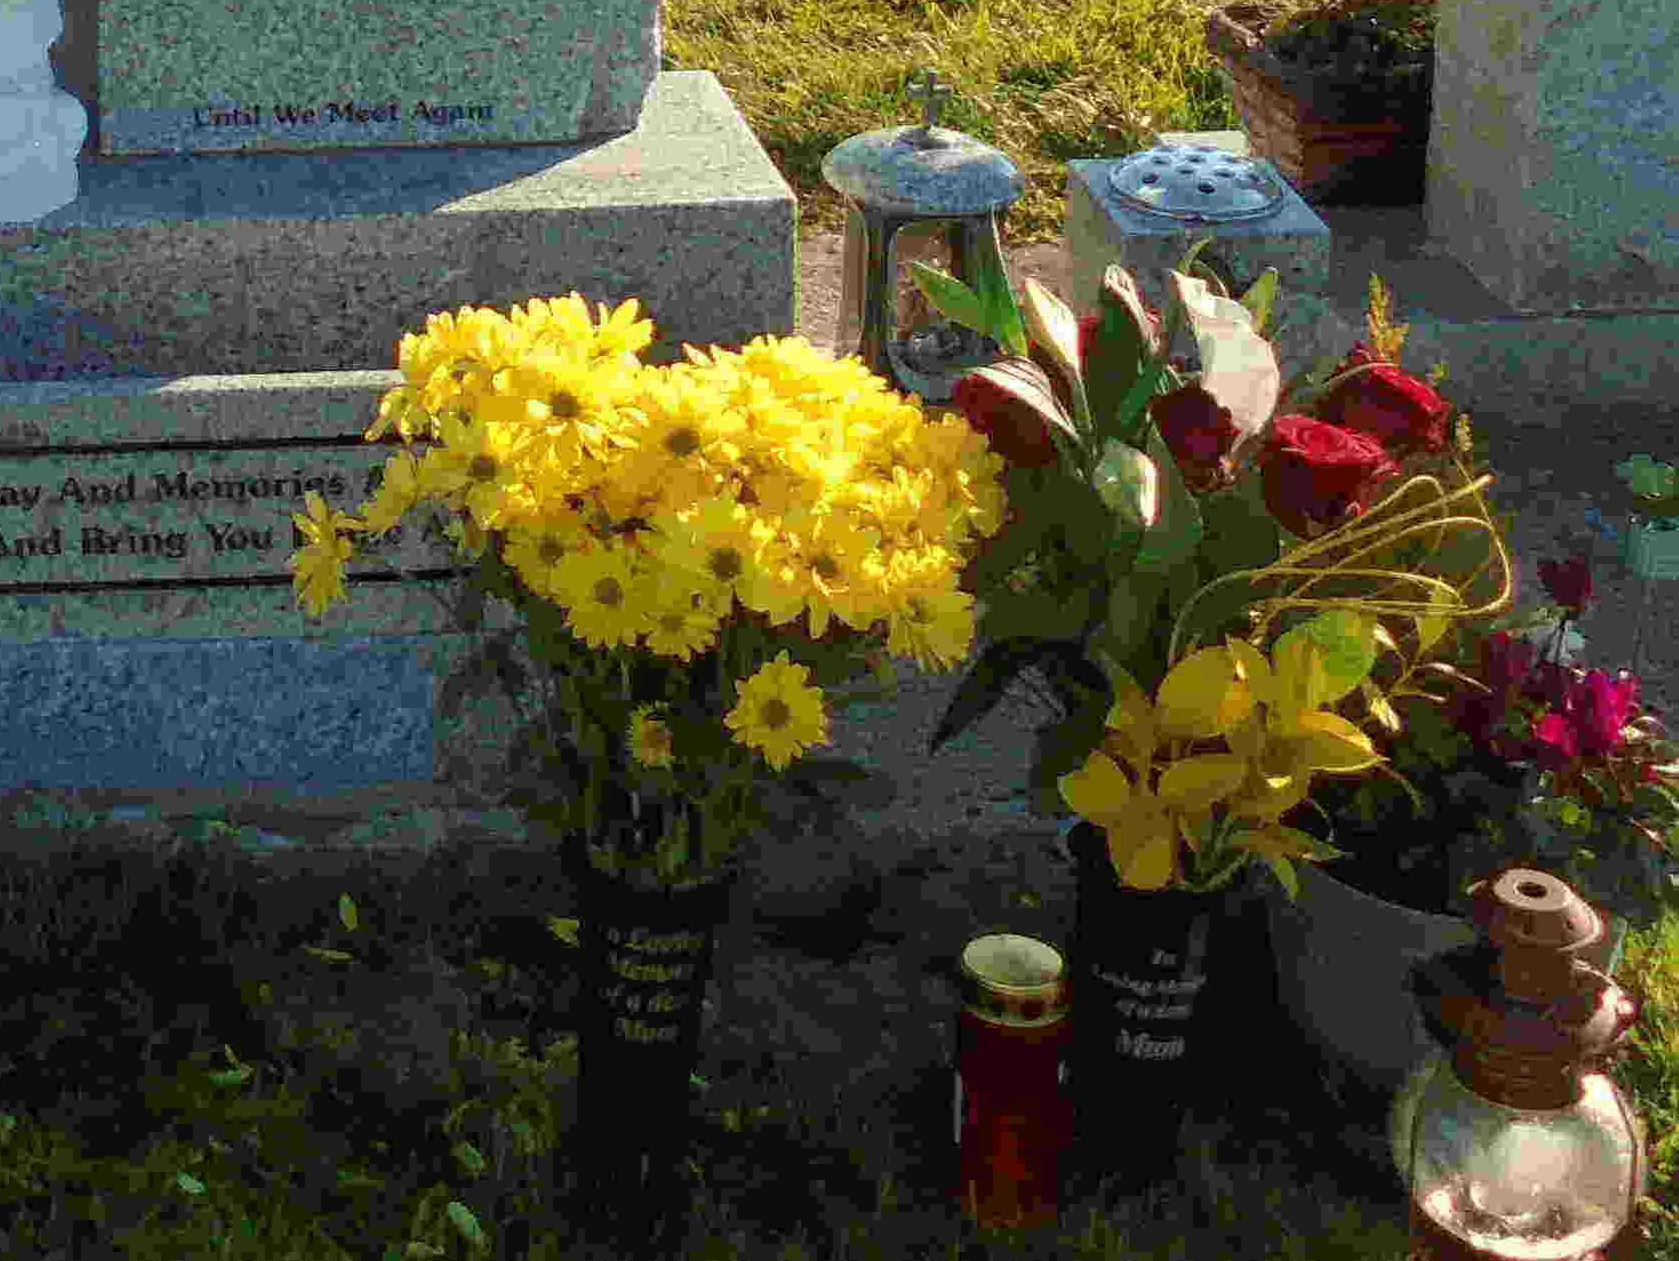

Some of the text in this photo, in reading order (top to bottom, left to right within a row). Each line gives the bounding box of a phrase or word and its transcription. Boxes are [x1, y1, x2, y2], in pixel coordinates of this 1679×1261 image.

[193, 100, 495, 128] Until We Meet Again
[59, 475, 136, 504] And
[152, 470, 347, 503] Memories
[79, 523, 188, 558] Bring
[205, 522, 274, 554] You
